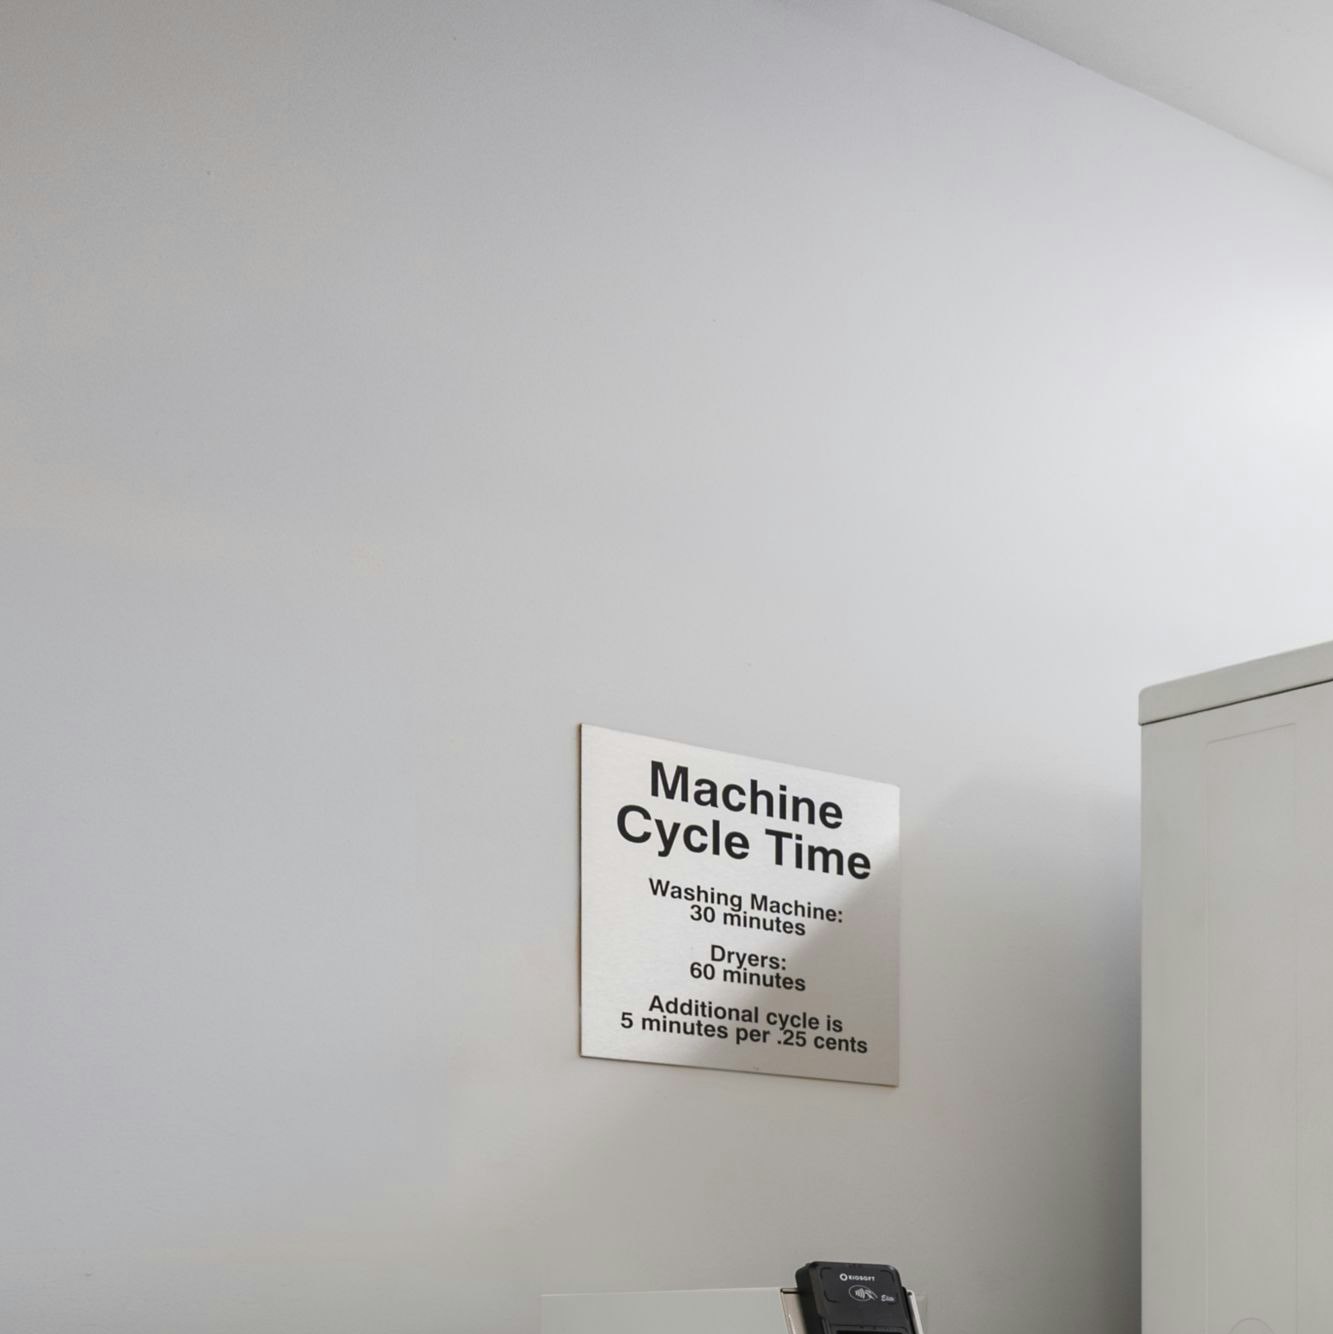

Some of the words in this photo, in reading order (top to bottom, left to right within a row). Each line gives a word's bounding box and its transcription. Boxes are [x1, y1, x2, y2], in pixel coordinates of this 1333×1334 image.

[651, 760, 843, 829] Machine
[617, 805, 750, 859] Cycle
[765, 829, 871, 880] Time
[649, 878, 742, 912] Washing
[751, 894, 843, 922] Machine:
[690, 905, 715, 923] 30
[723, 910, 806, 935] minutes
[690, 962, 715, 979] 60
[723, 968, 806, 991] minutes
[711, 945, 786, 970] Dryers:
[621, 1012, 633, 1028] 5
[642, 1016, 728, 1039] minutes
[736, 1027, 769, 1045] per
[777, 1030, 807, 1047] .25
[814, 1033, 868, 1053] cents
[649, 995, 758, 1023] Additional
[766, 1012, 819, 1032] cycle
[827, 1016, 843, 1032] is
